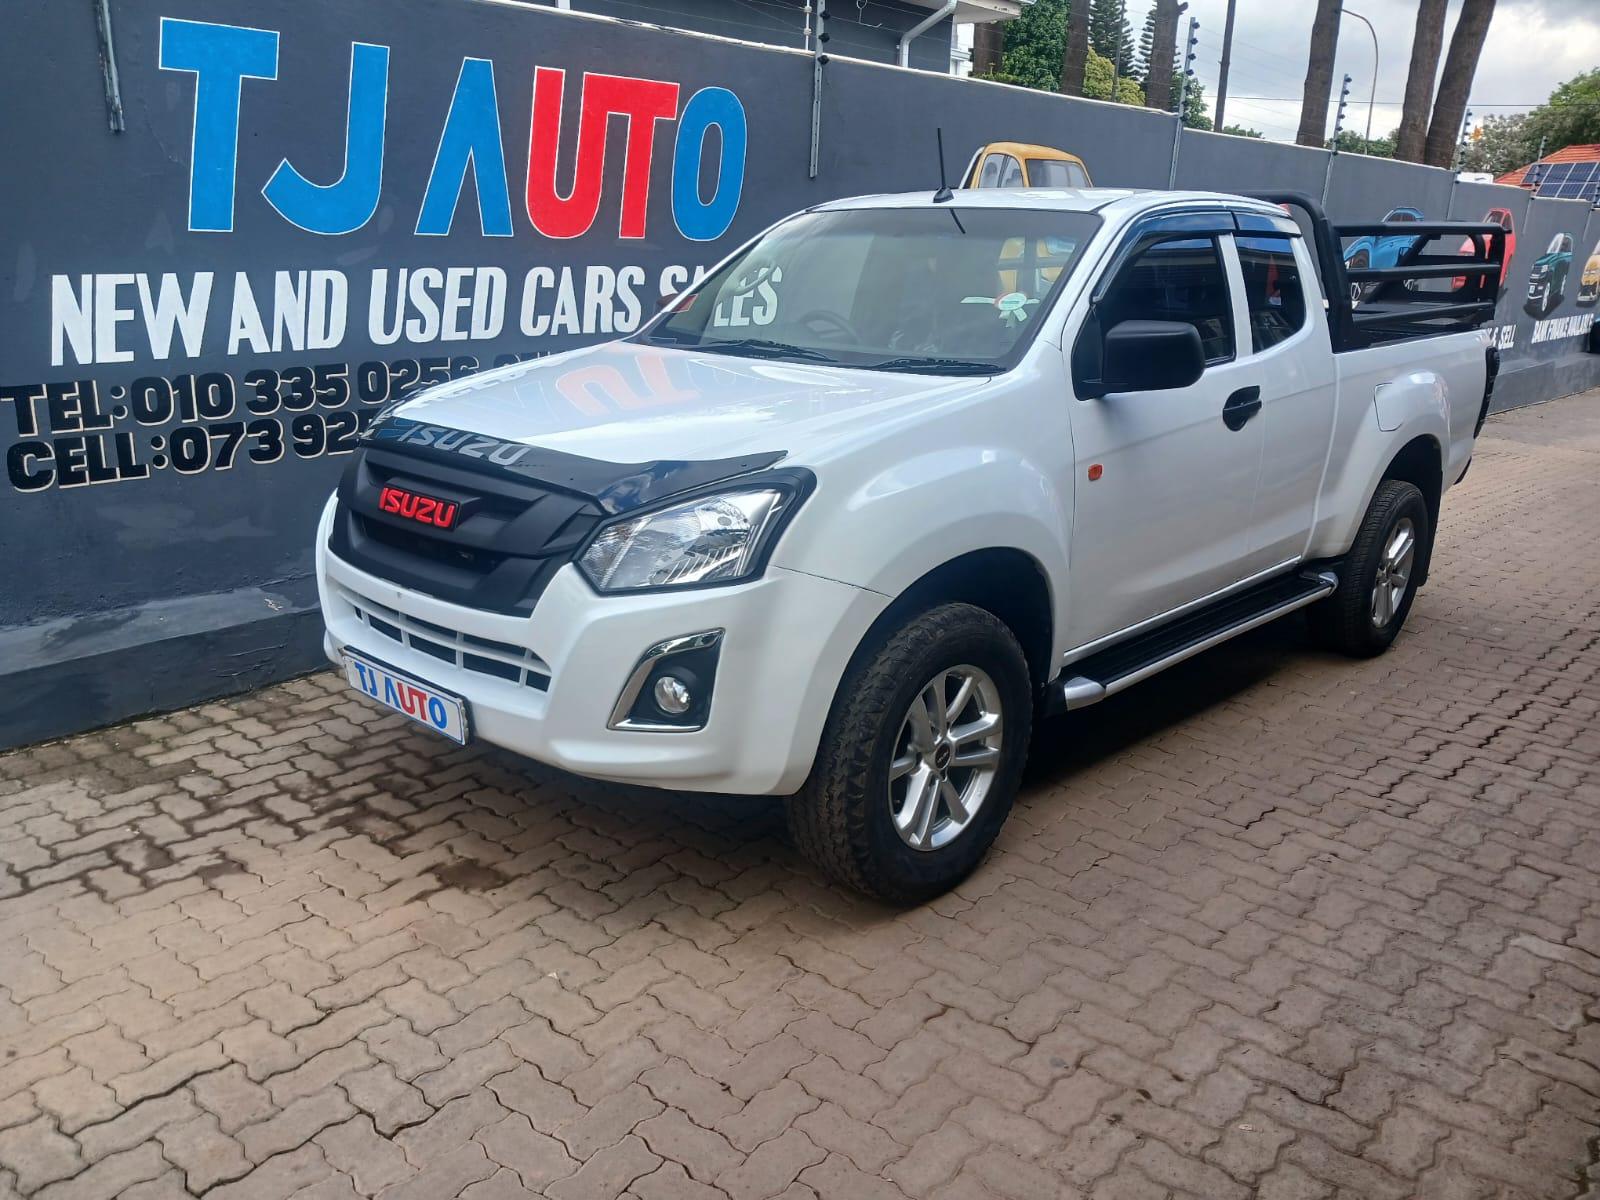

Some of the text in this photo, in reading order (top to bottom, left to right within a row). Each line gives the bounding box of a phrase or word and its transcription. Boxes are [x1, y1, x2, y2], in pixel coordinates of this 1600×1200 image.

[159, 17, 747, 241] TJ AUTO
[51, 265, 782, 366] NEW AND USED CARS SLES
[1498, 324, 1516, 350] SELL
[244, 363, 350, 415] 335
[399, 424, 532, 466] ISUZU
[379, 487, 455, 528] ISUZU
[354, 661, 448, 730] TJ AUTO
